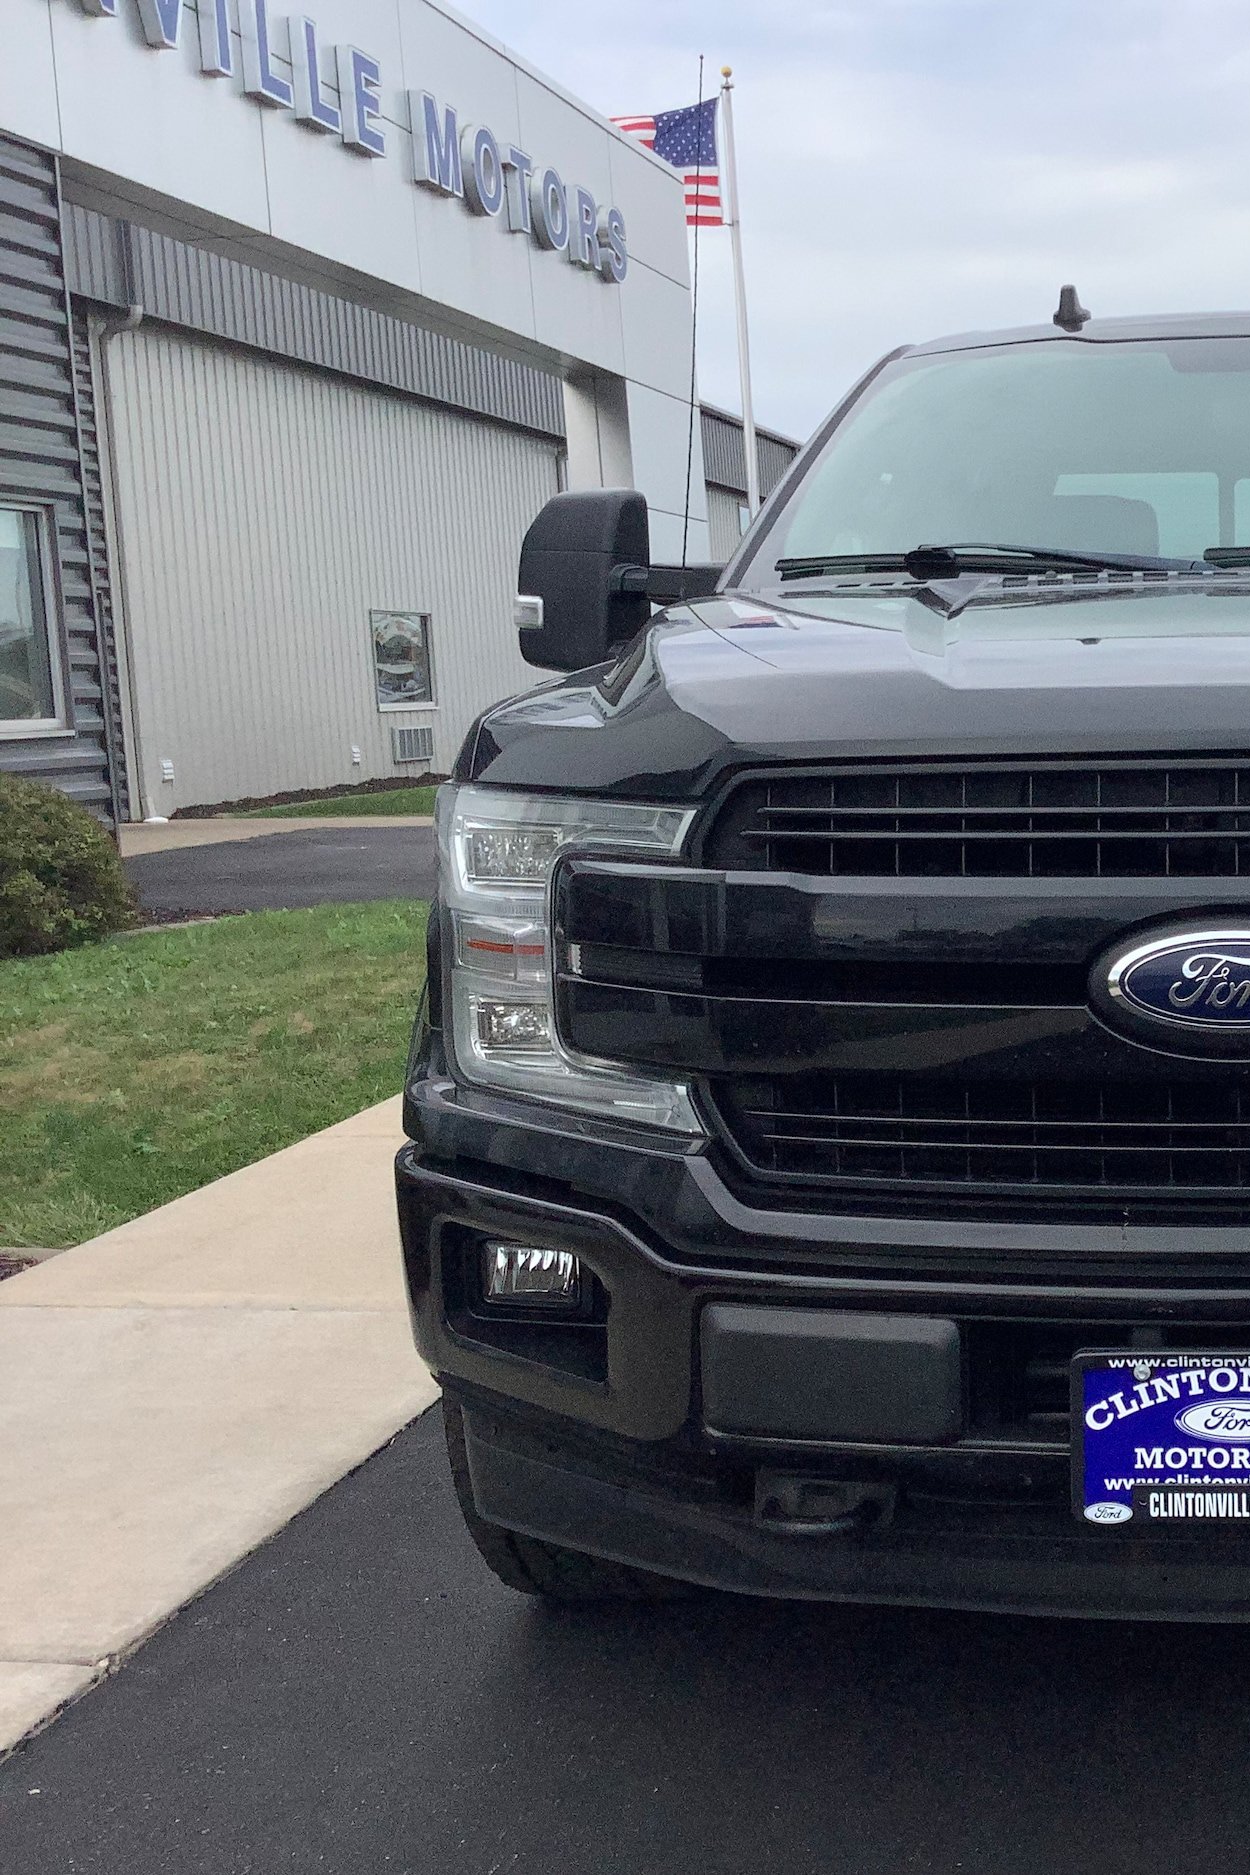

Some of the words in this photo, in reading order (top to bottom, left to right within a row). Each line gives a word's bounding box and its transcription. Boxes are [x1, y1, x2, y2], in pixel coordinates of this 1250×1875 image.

[82, 0, 386, 158] ILLE
[409, 90, 628, 284] MOTORS
[1093, 1506, 1123, 1520] Ford
